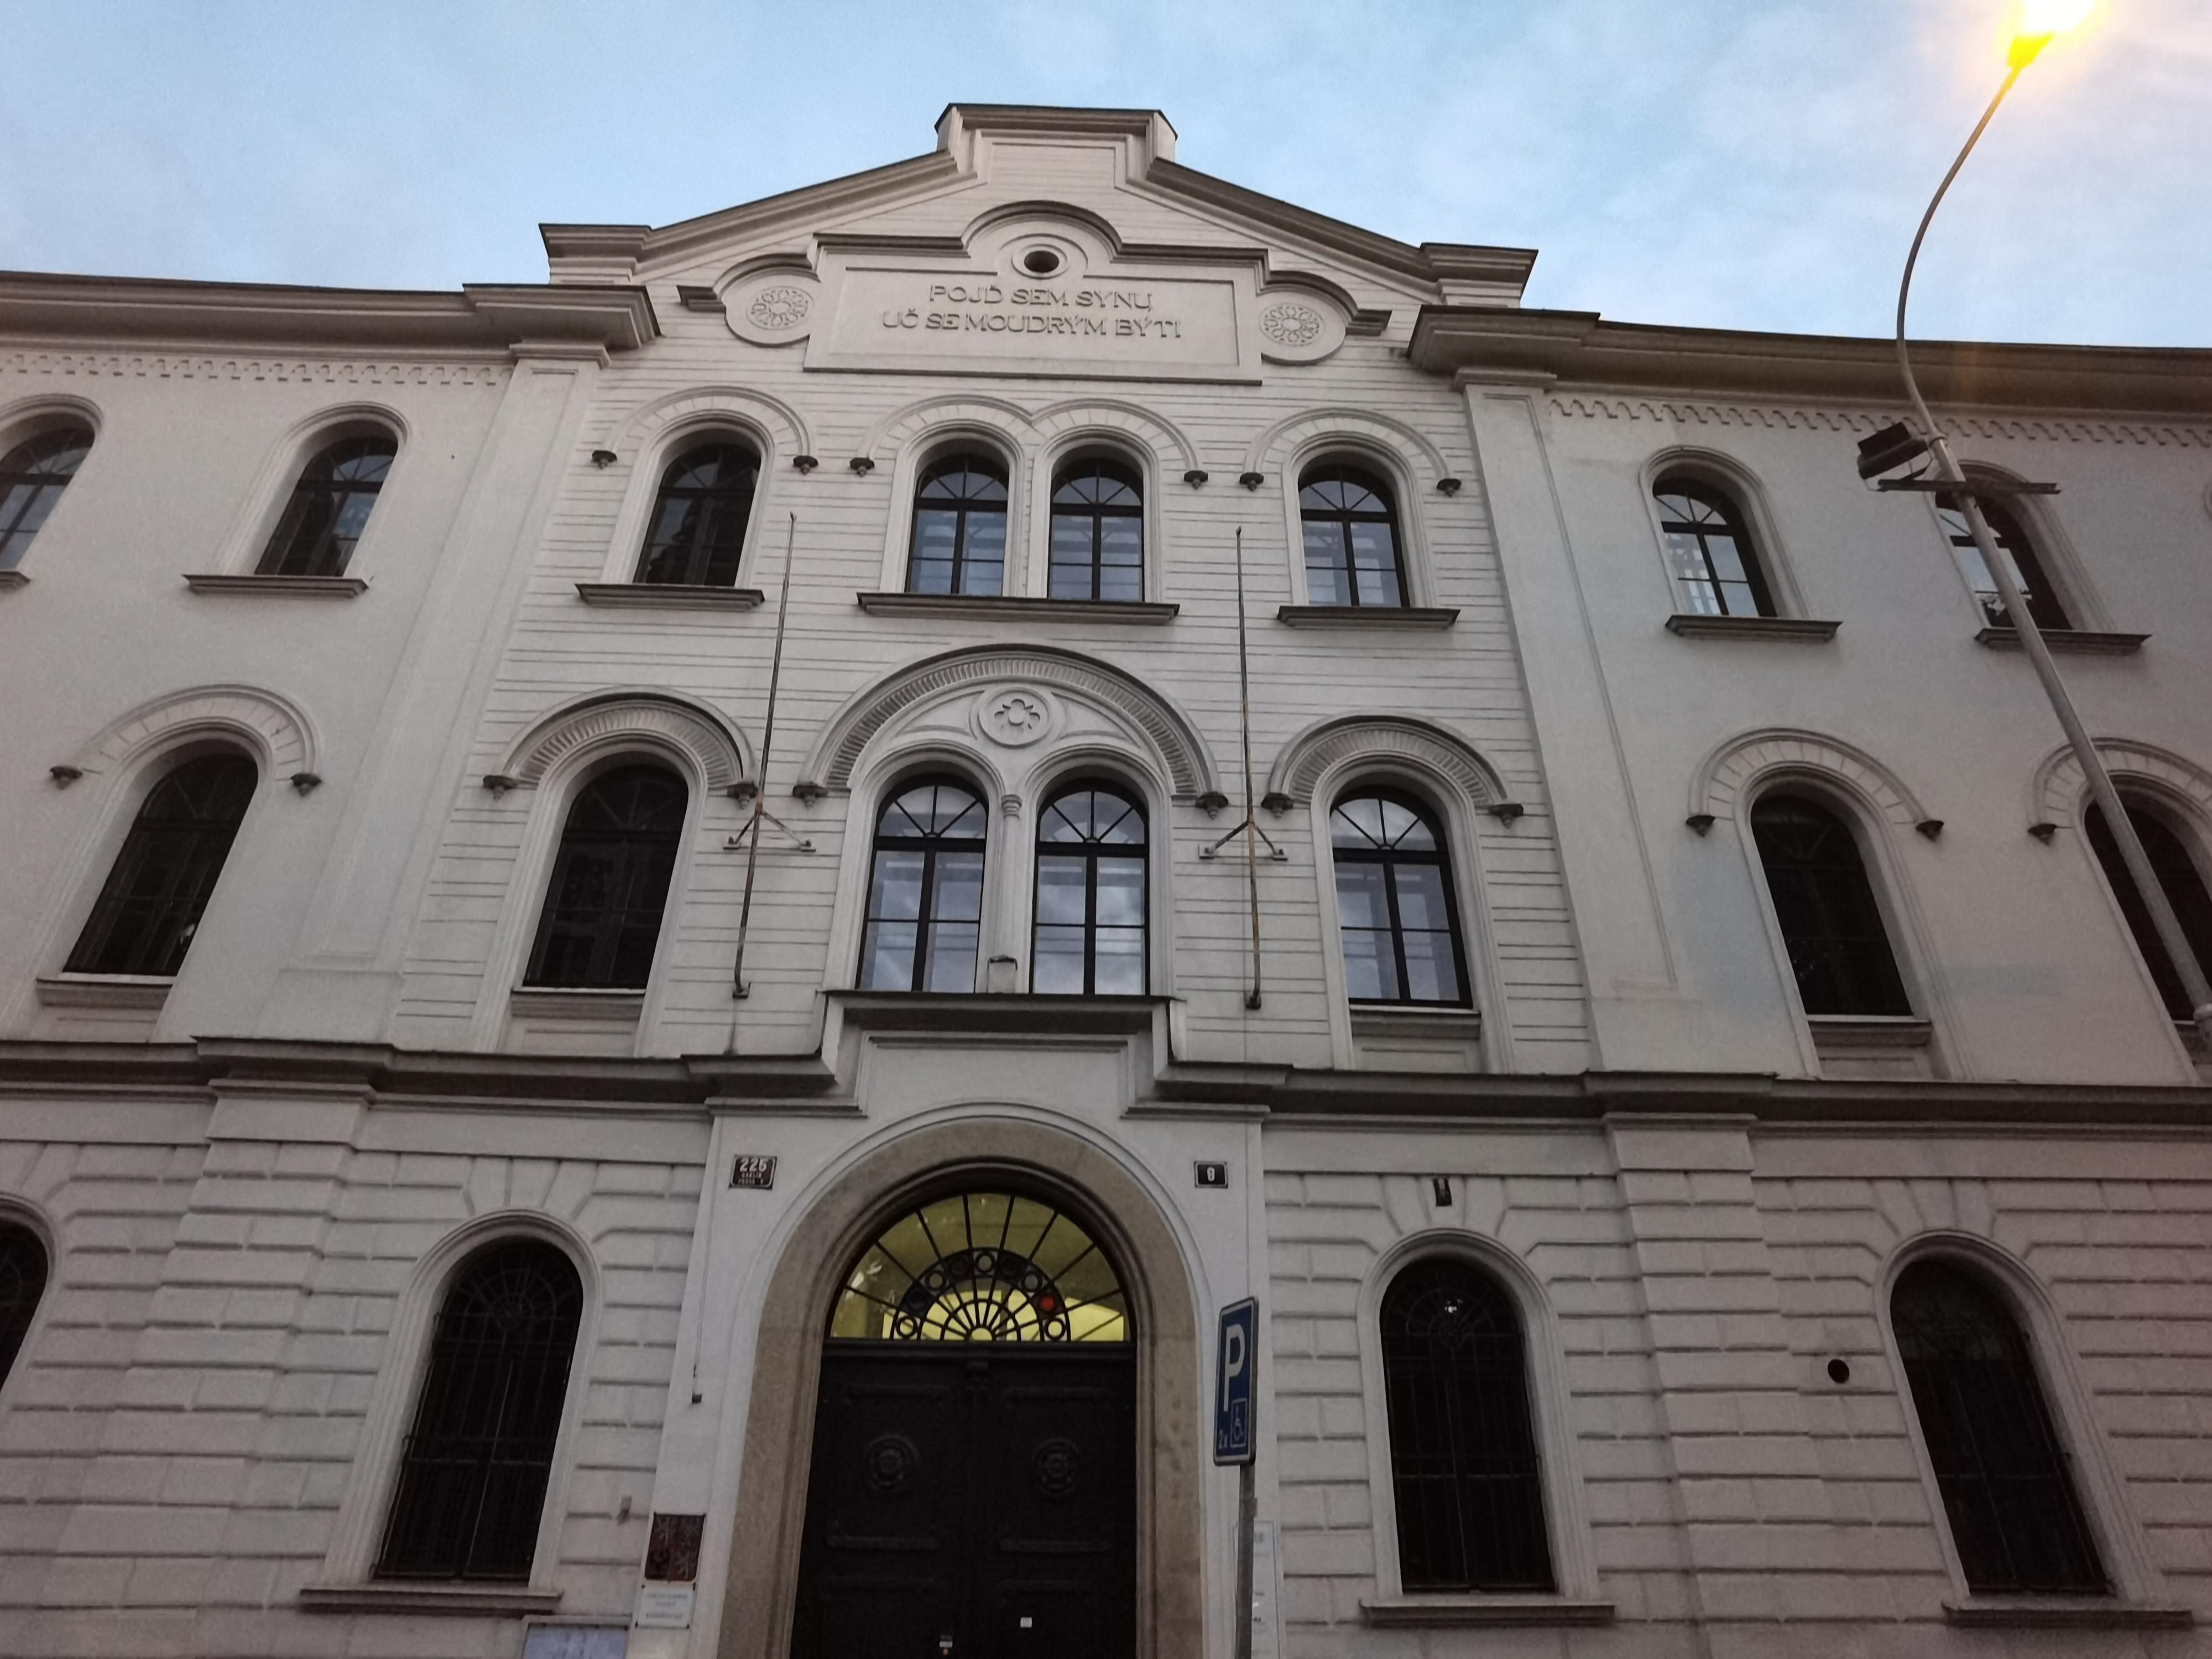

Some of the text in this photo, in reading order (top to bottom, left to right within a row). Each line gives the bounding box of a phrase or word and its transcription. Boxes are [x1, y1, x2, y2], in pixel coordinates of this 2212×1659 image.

[1011, 289, 1068, 305] SEM
[883, 309, 1181, 338] UČ SE MOUDRÝM BÝTI
[740, 1159, 767, 1172] 226
[1223, 1324, 1245, 1411] P
